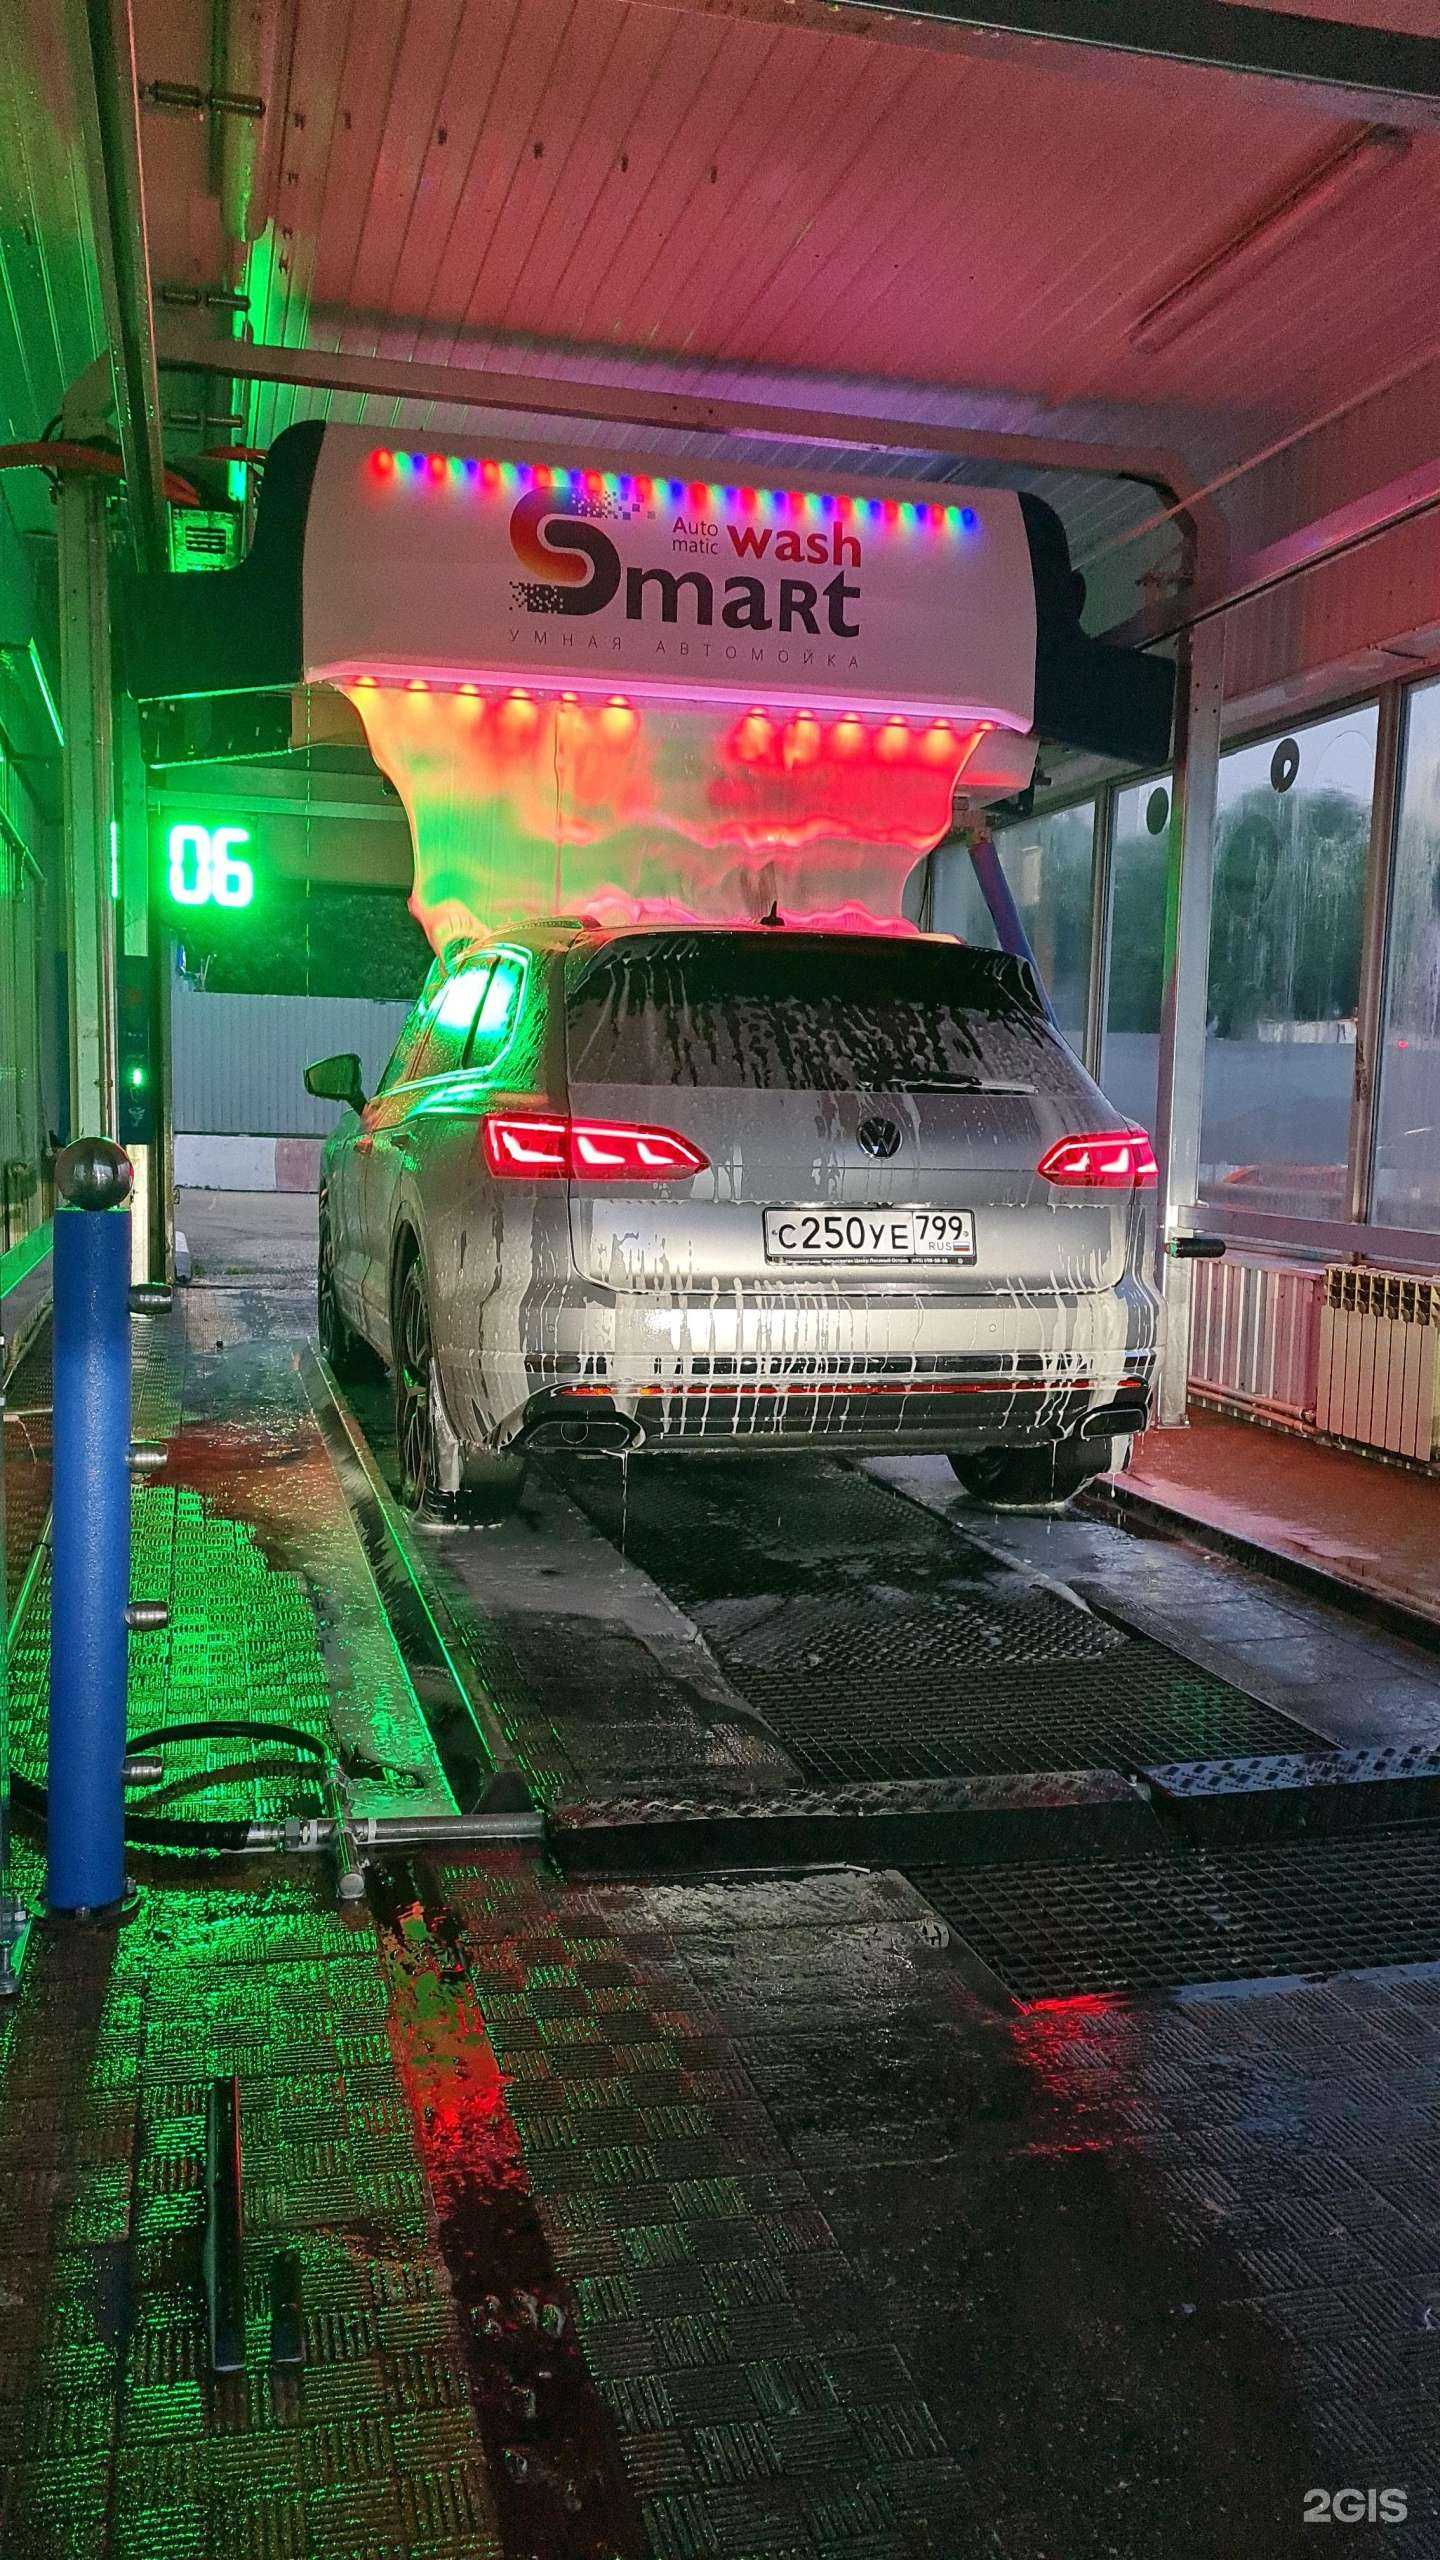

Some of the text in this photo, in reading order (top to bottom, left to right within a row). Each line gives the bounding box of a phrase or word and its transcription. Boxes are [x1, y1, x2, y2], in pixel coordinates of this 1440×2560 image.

[673, 516, 719, 538] Auto
[672, 537, 719, 555] matic
[726, 521, 862, 568] wash
[509, 629, 859, 669] УМНАЯ АВТОМОЙКА
[168, 824, 254, 907] 06
[915, 1214, 963, 1241] 799
[928, 1241, 952, 1251] RUS
